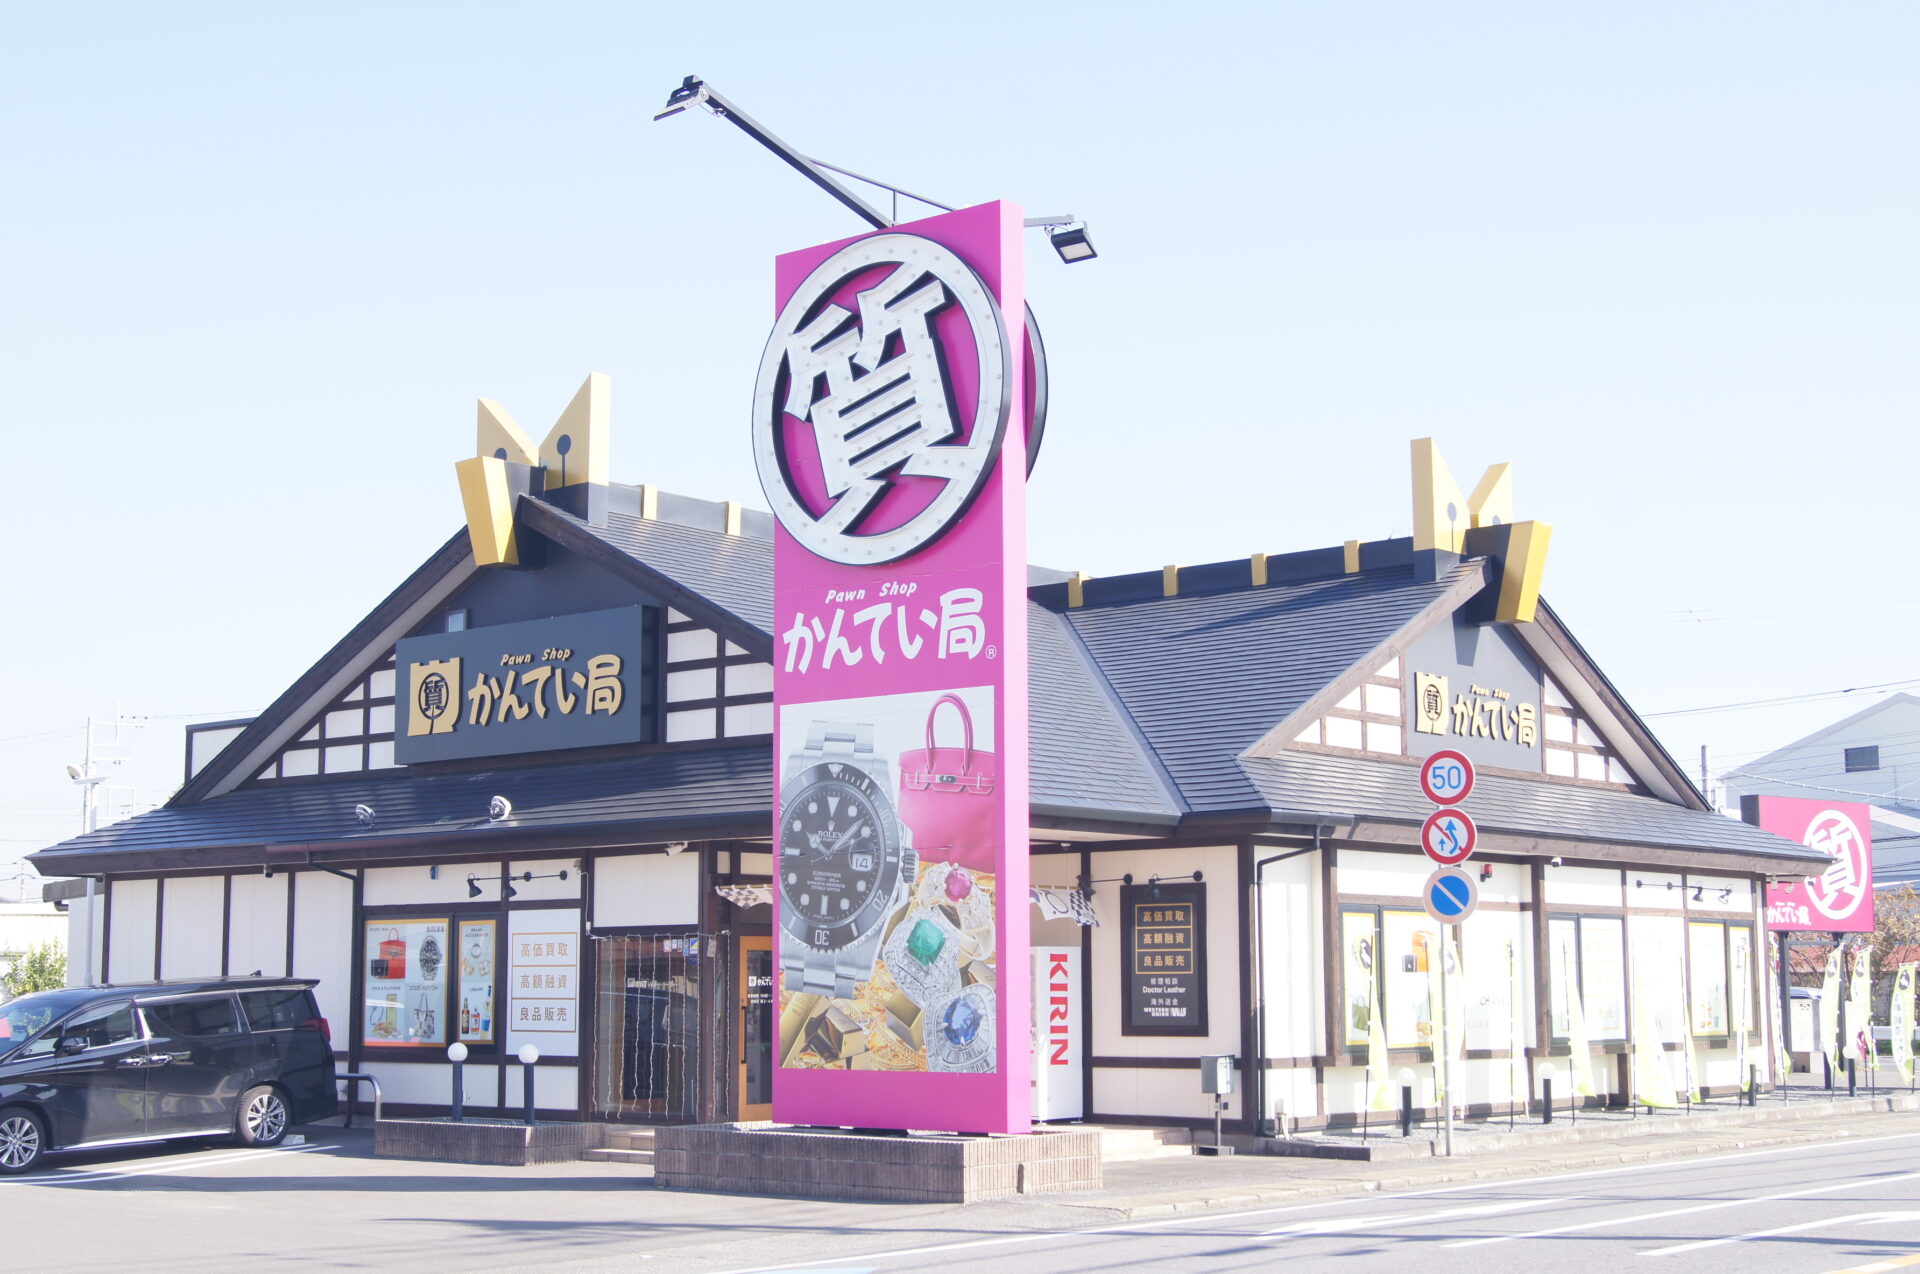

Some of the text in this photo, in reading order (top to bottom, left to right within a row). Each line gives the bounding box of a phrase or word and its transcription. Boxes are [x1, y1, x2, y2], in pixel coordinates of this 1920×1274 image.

[825, 581, 917, 604] Pawn Shop
[782, 587, 986, 675] かんてい局
[500, 648, 572, 666] Pawn Shop
[421, 676, 447, 714] 質
[467, 653, 624, 727] かんてい局
[1472, 684, 1490, 697] Pawn
[1452, 693, 1537, 748] かんてい局
[1432, 765, 1462, 790] 50
[818, 830, 844, 839] ROLEX
[855, 857, 870, 869] 14
[1143, 910, 1185, 922] 高価買取
[1767, 905, 1809, 925] かんてい局
[814, 929, 830, 946] 30
[1143, 932, 1185, 945] 高額融資
[520, 942, 568, 957] 高価買取
[1143, 955, 1185, 967] 良品販売
[520, 974, 568, 989] 高額融資
[1142, 986, 1186, 994] Doctor Leather
[1049, 953, 1069, 1065] KIRIN
[1150, 998, 1179, 1006] 海外送金
[519, 1006, 567, 1022] 良品販売
